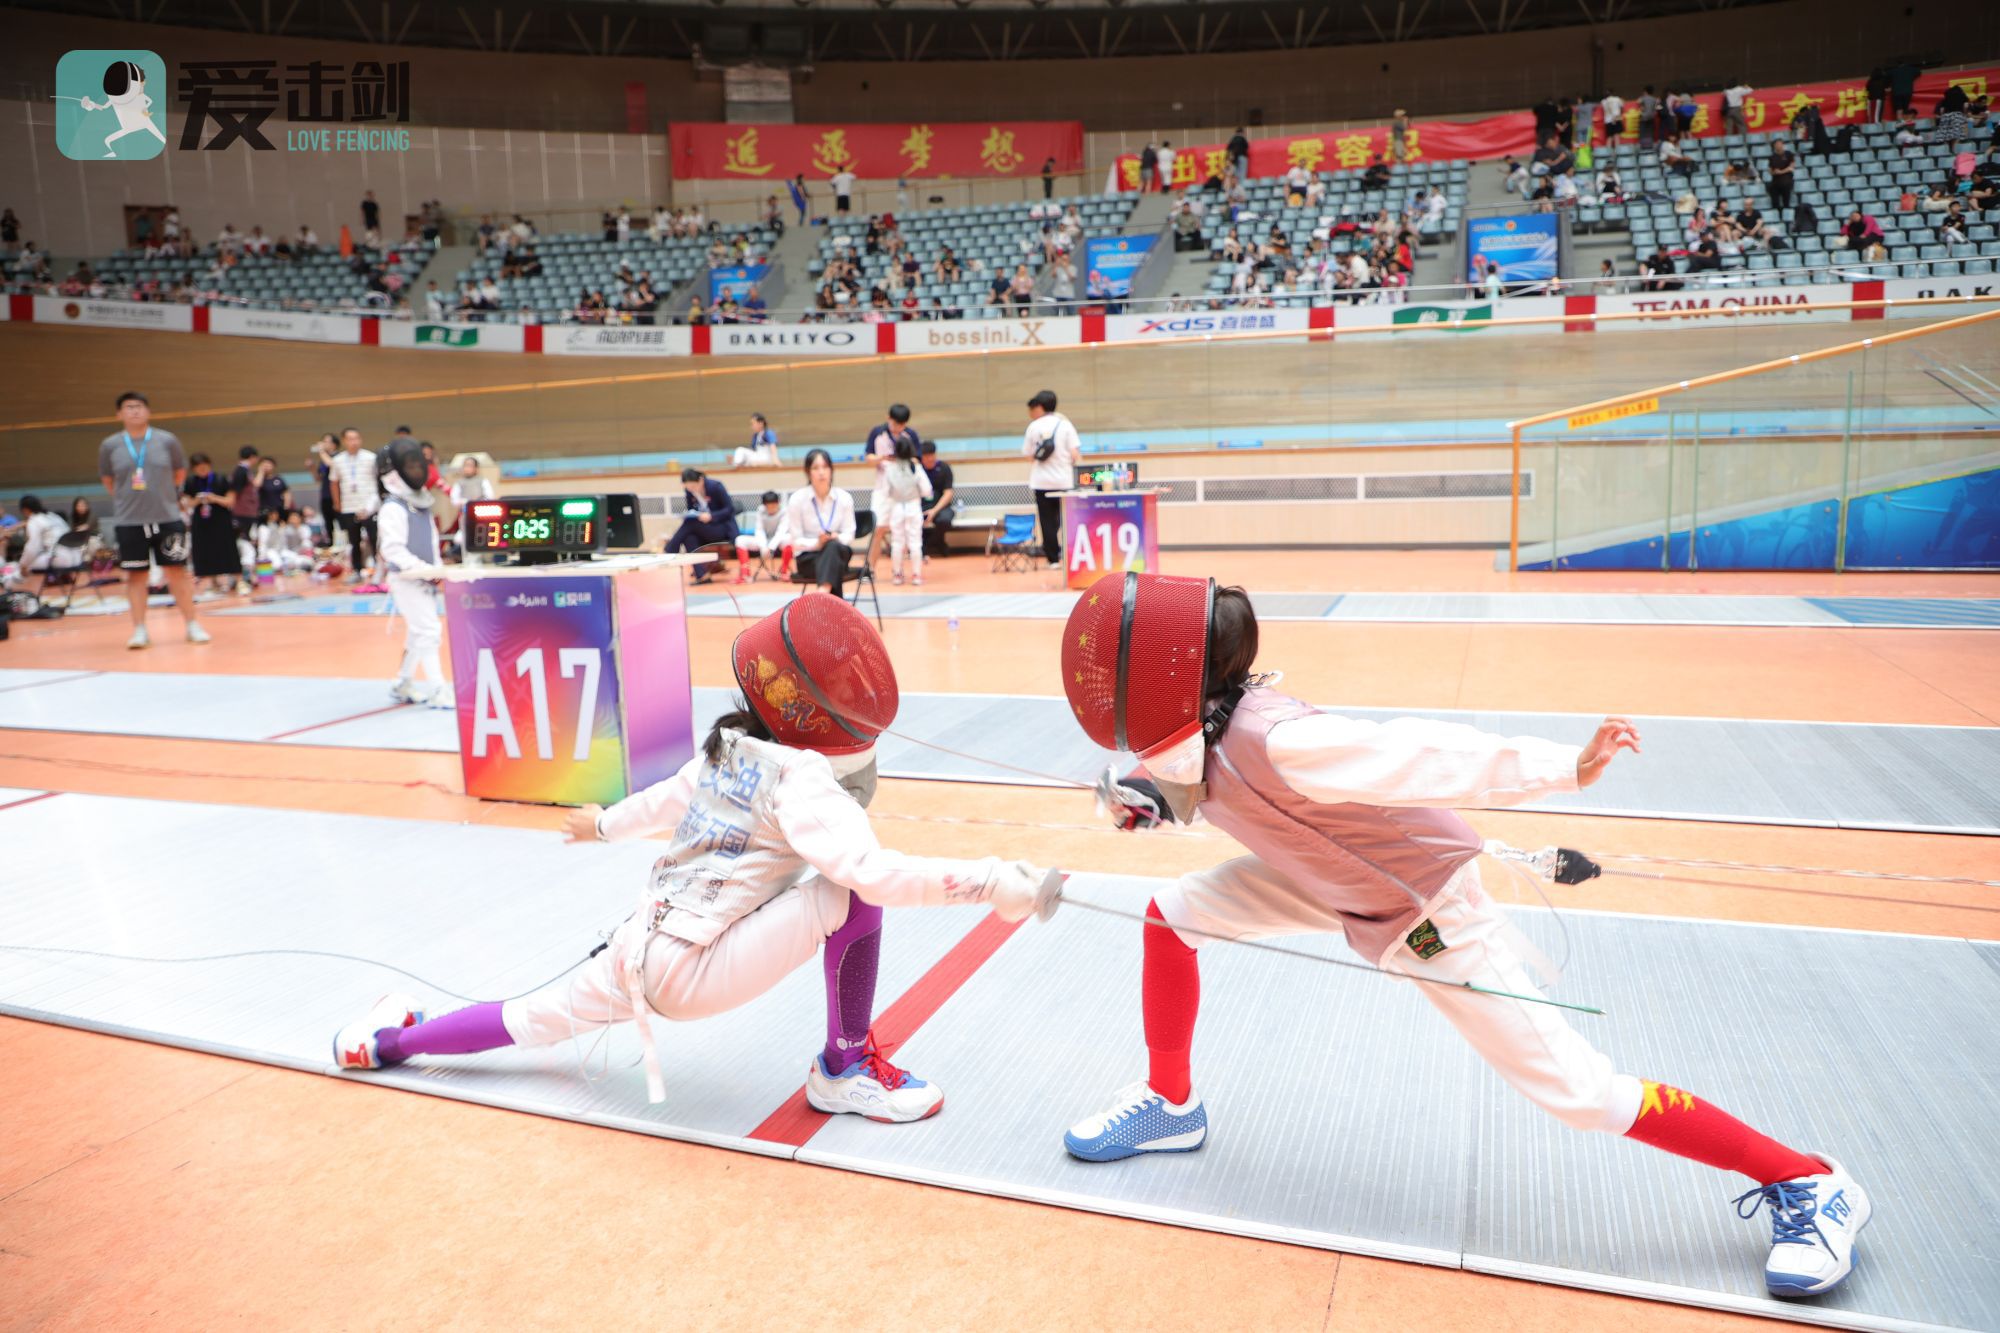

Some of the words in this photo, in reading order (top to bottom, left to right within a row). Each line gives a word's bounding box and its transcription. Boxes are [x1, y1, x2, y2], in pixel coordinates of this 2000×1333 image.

[1632, 299, 1710, 321] TEAM
[1720, 294, 1813, 317] CHINA
[729, 333, 819, 346] OAKLEY
[487, 522, 500, 547] 3
[513, 519, 550, 539] 0:25
[1069, 522, 1140, 572] A19
[471, 647, 602, 761] A17
